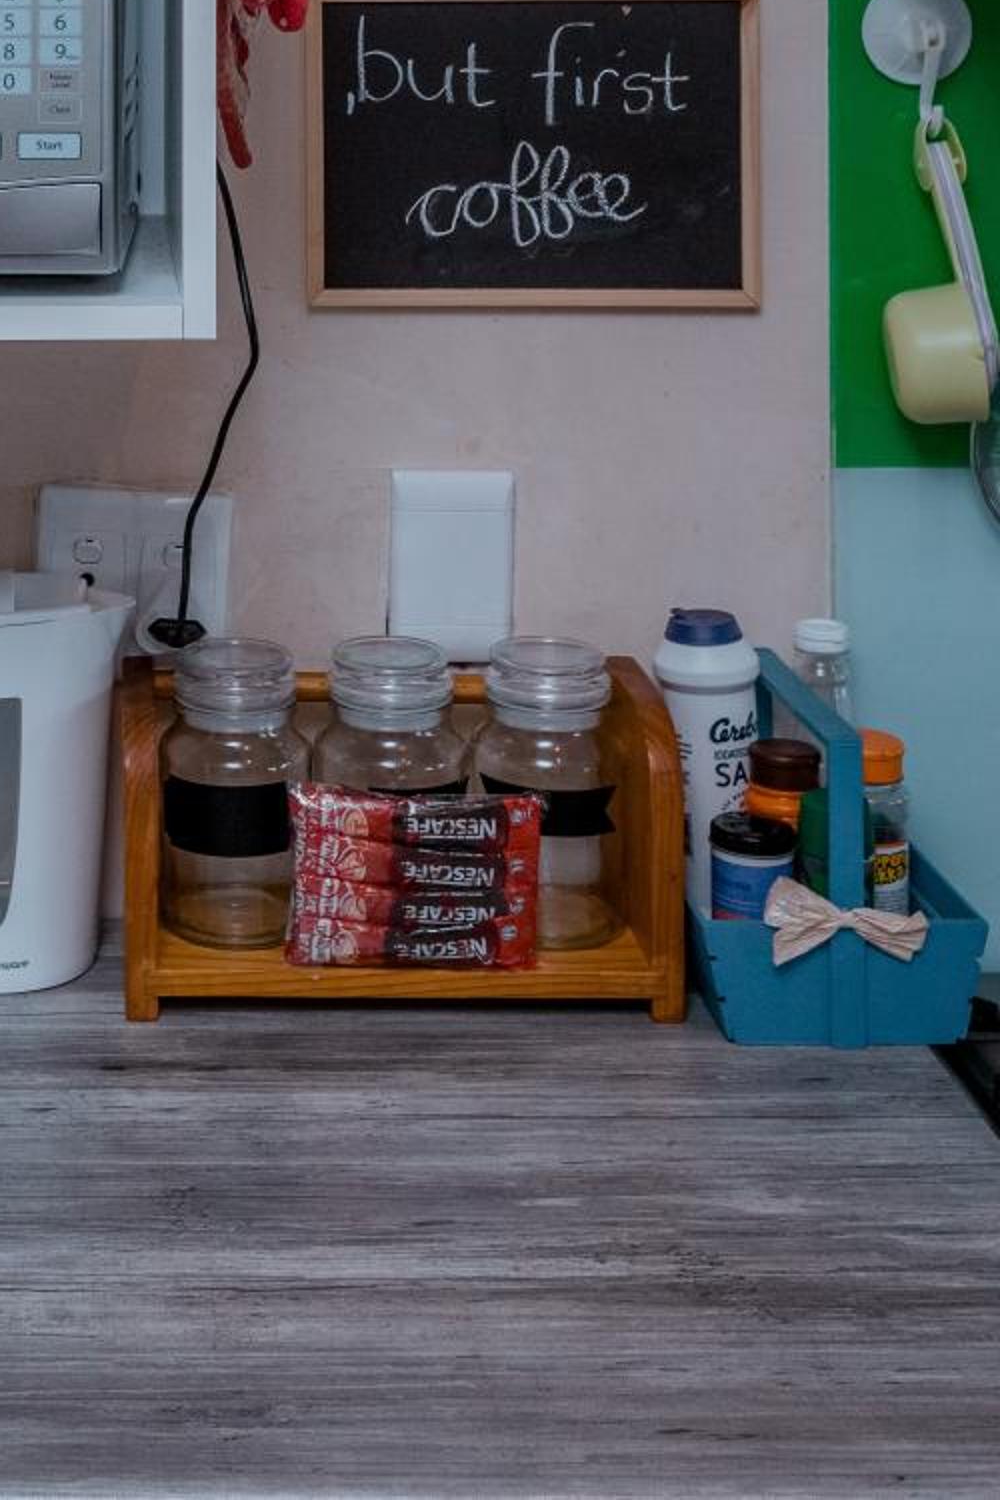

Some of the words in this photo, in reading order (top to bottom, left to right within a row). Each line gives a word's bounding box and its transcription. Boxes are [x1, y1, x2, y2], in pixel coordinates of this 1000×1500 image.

[4, 13, 15, 31] 5
[54, 13, 67, 31] 6
[3, 43, 16, 60] 8
[55, 43, 67, 59] 9
[3, 72, 16, 90] 0
[531, 21, 690, 126] first
[36, 138, 63, 151] Start
[405, 140, 646, 246] coffee
[714, 760, 749, 788] SA
